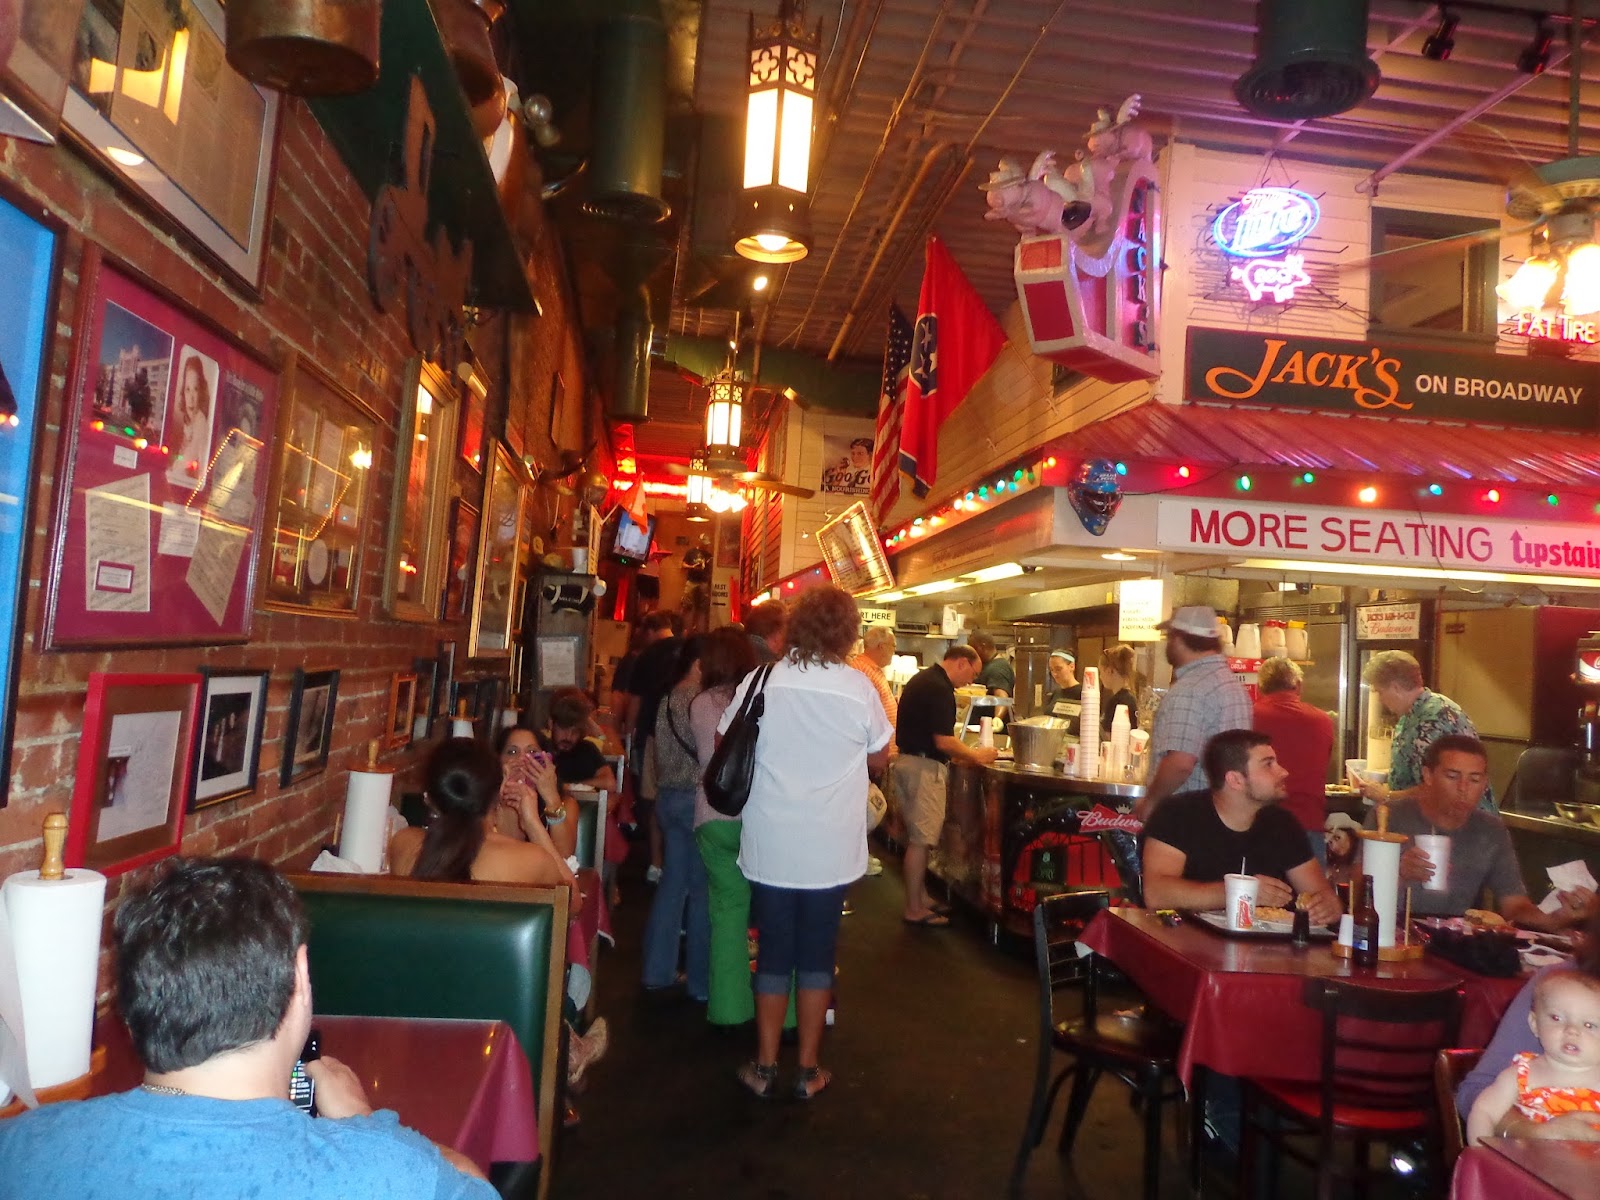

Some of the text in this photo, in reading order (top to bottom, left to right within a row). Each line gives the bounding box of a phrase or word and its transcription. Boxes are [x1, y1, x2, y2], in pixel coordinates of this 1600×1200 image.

[1205, 338, 1583, 410] JACK'S ON BROADWAY
[1189, 508, 1308, 550] MORE
[1320, 516, 1494, 562] SEATING
[872, 612, 891, 620] HERE
